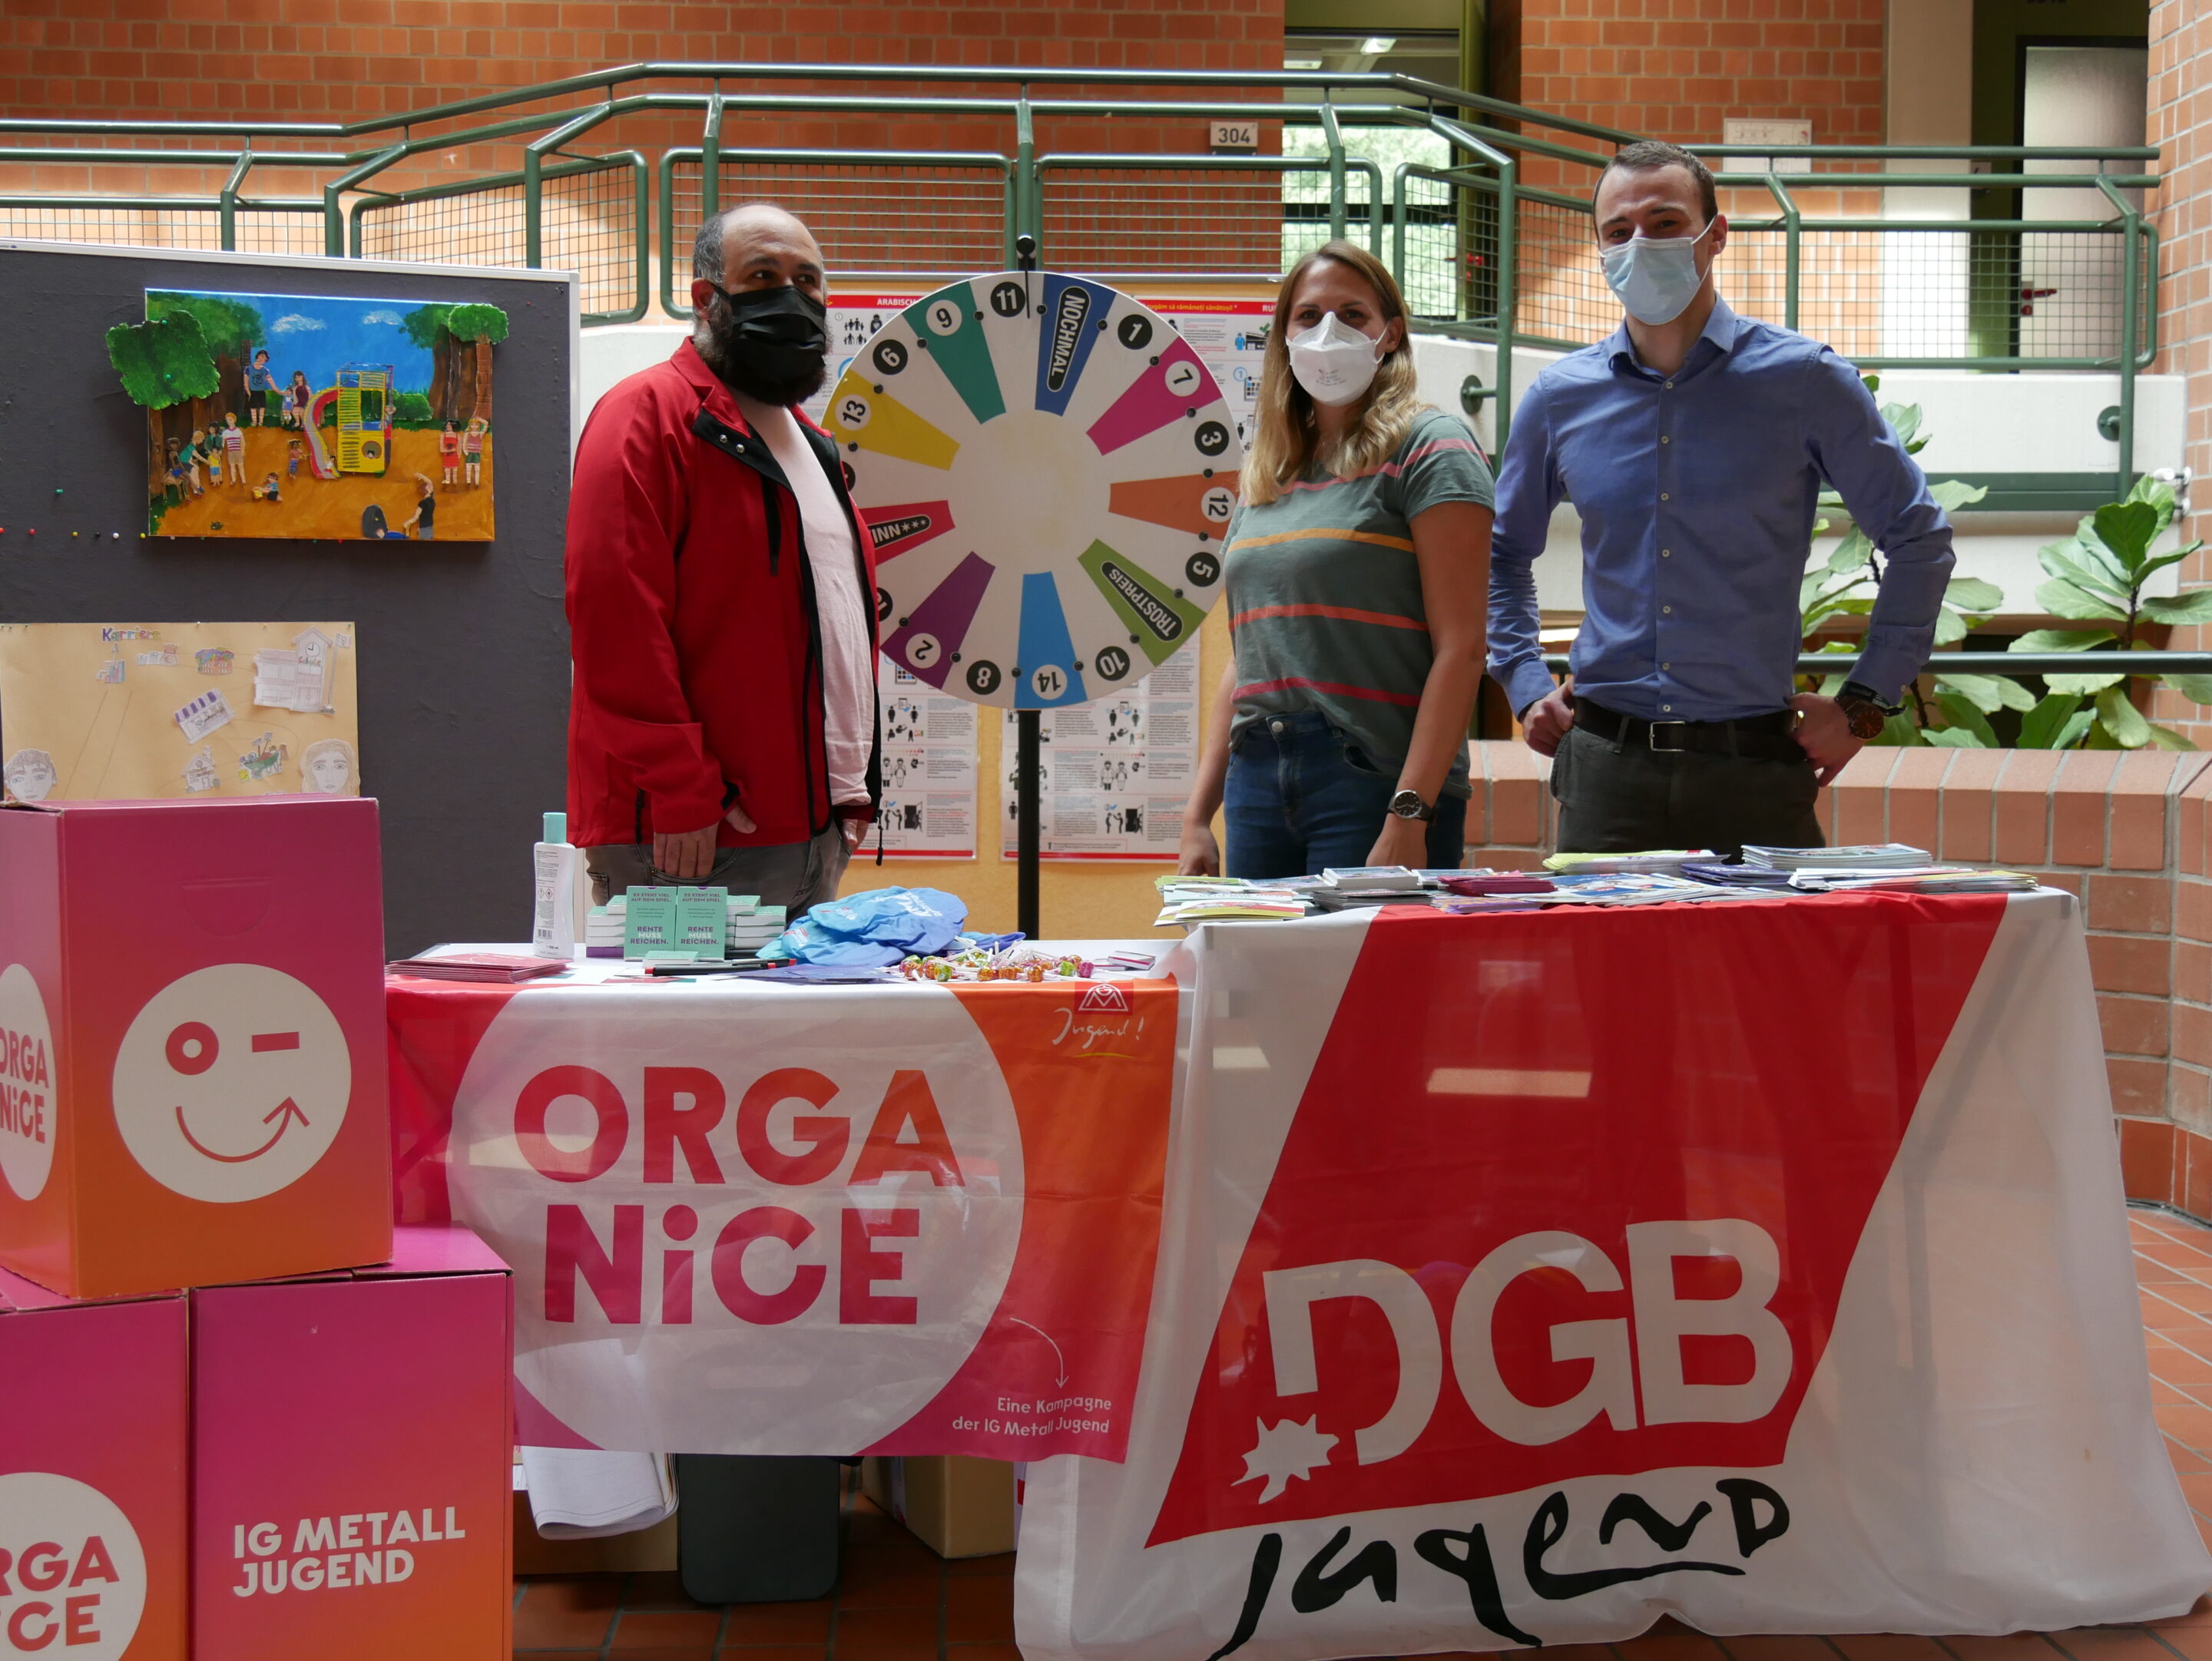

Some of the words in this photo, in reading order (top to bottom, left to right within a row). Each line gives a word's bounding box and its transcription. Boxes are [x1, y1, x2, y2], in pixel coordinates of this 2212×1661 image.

[1218, 127, 1251, 144] 304
[995, 290, 1018, 309] 11
[935, 308, 952, 329] 9
[1051, 294, 1086, 377] NOCHMAL
[1128, 323, 1143, 342] 1
[881, 348, 900, 367] 6
[1173, 368, 1194, 385] 7
[842, 400, 866, 425] 13
[1200, 430, 1222, 447] 3
[1208, 494, 1229, 517] 12
[1192, 561, 1214, 578] 5
[1108, 568, 1177, 637] TROSTPREIS
[915, 640, 933, 660] 2
[1099, 651, 1125, 677] 10
[976, 667, 992, 688] 8
[1037, 671, 1061, 693] 14
[513, 1064, 965, 1187] ORGA
[1263, 1217, 1793, 1467] DGB
[997, 1397, 1031, 1414] Eine
[1036, 1396, 1112, 1414] Kampagne
[952, 1416, 981, 1431] der
[984, 1418, 1000, 1433] IG
[1004, 1420, 1054, 1437] Metall
[1055, 1417, 1110, 1434] Jugend
[233, 1521, 283, 1559] IG
[292, 1506, 466, 1553] METALL
[233, 1549, 415, 1598] JUGEND
[0, 1593, 101, 1652] CE
